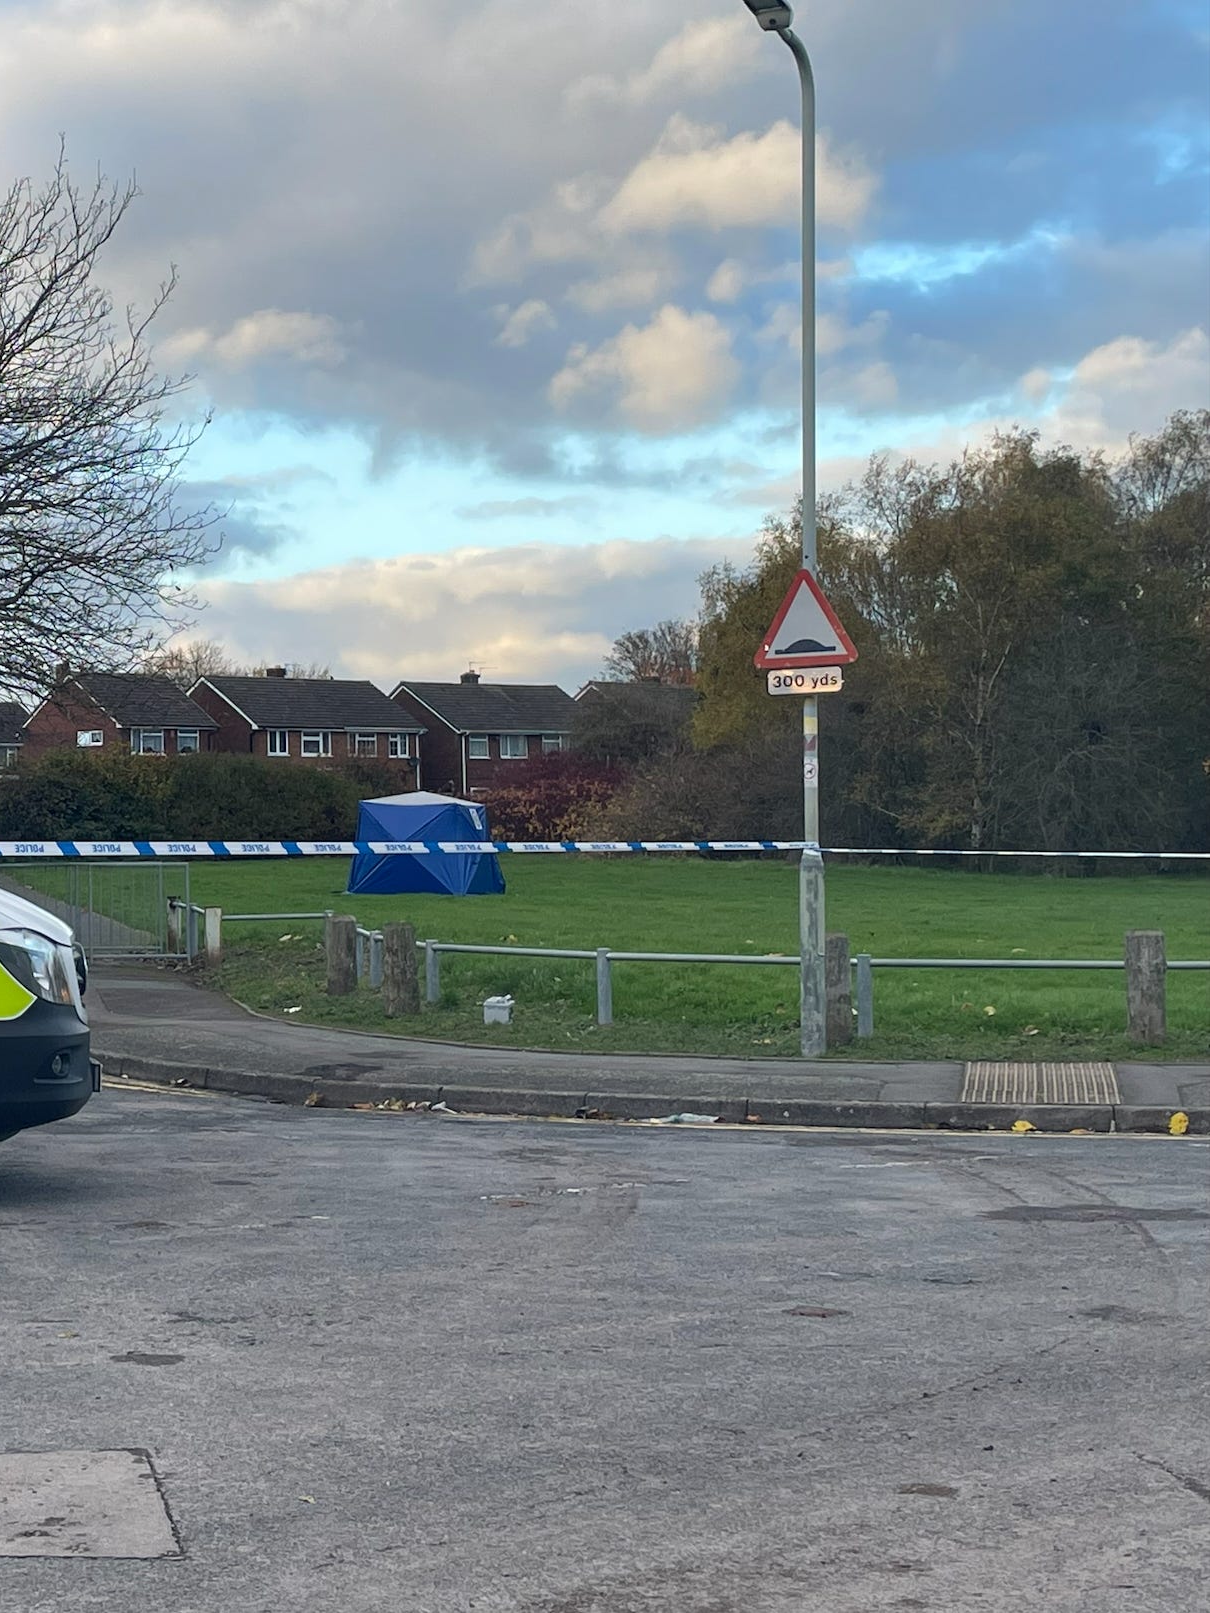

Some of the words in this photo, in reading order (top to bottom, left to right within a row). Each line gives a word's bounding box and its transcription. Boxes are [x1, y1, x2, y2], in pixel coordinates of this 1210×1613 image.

[772, 674, 805, 688] 300
[811, 673, 838, 689] yds
[15, 844, 44, 853] POLICE
[92, 844, 121, 853] POLICE
[167, 844, 197, 853] POLICE
[241, 844, 270, 852] POLICE
[314, 844, 342, 852] POLICE
